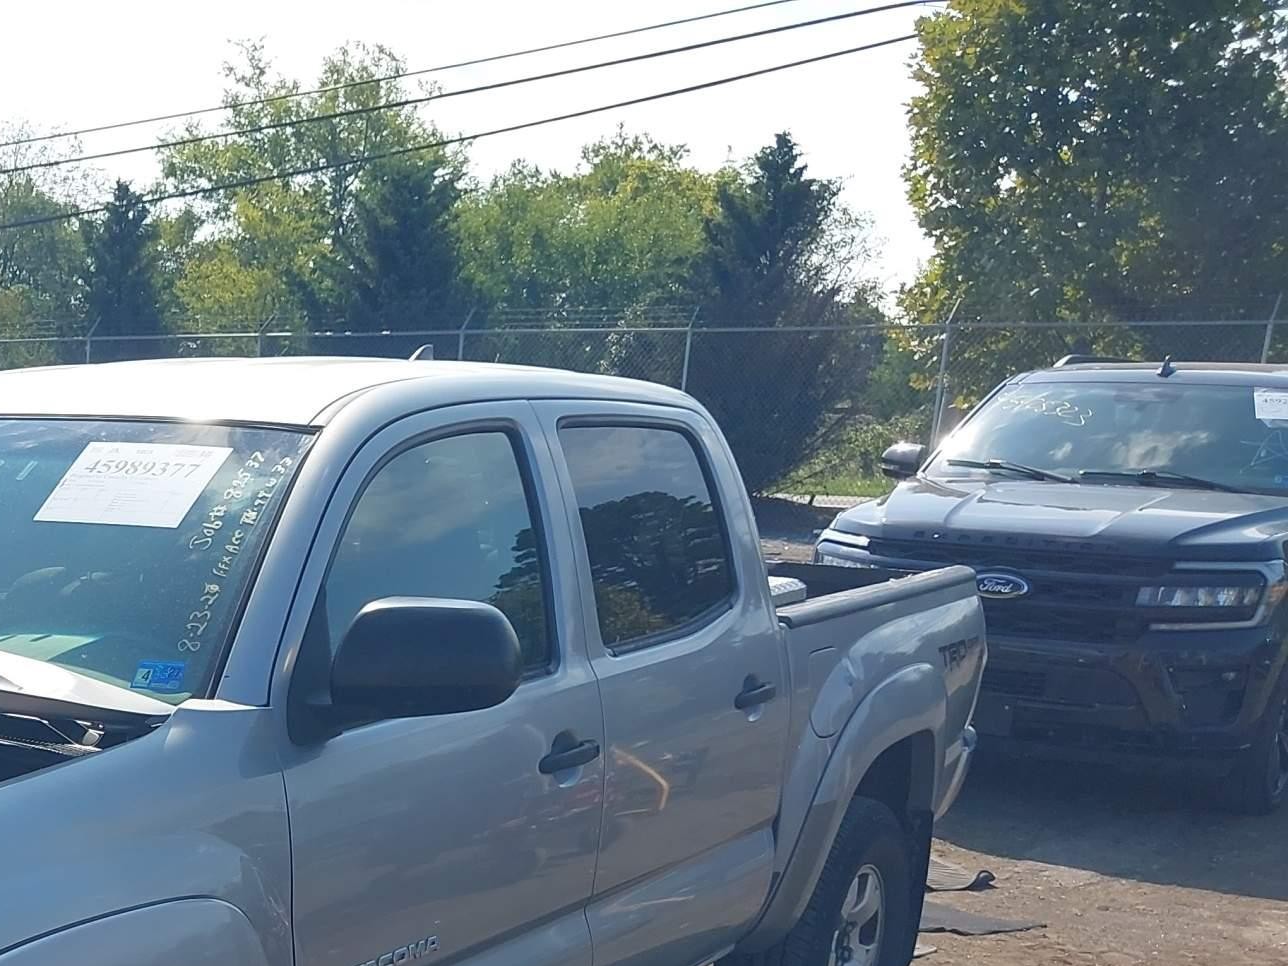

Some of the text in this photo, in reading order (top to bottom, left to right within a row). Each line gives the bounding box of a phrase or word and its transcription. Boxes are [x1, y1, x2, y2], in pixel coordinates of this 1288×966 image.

[84, 458, 201, 478] 45989377
[979, 577, 1013, 593] Ford
[141, 670, 151, 682] 4
